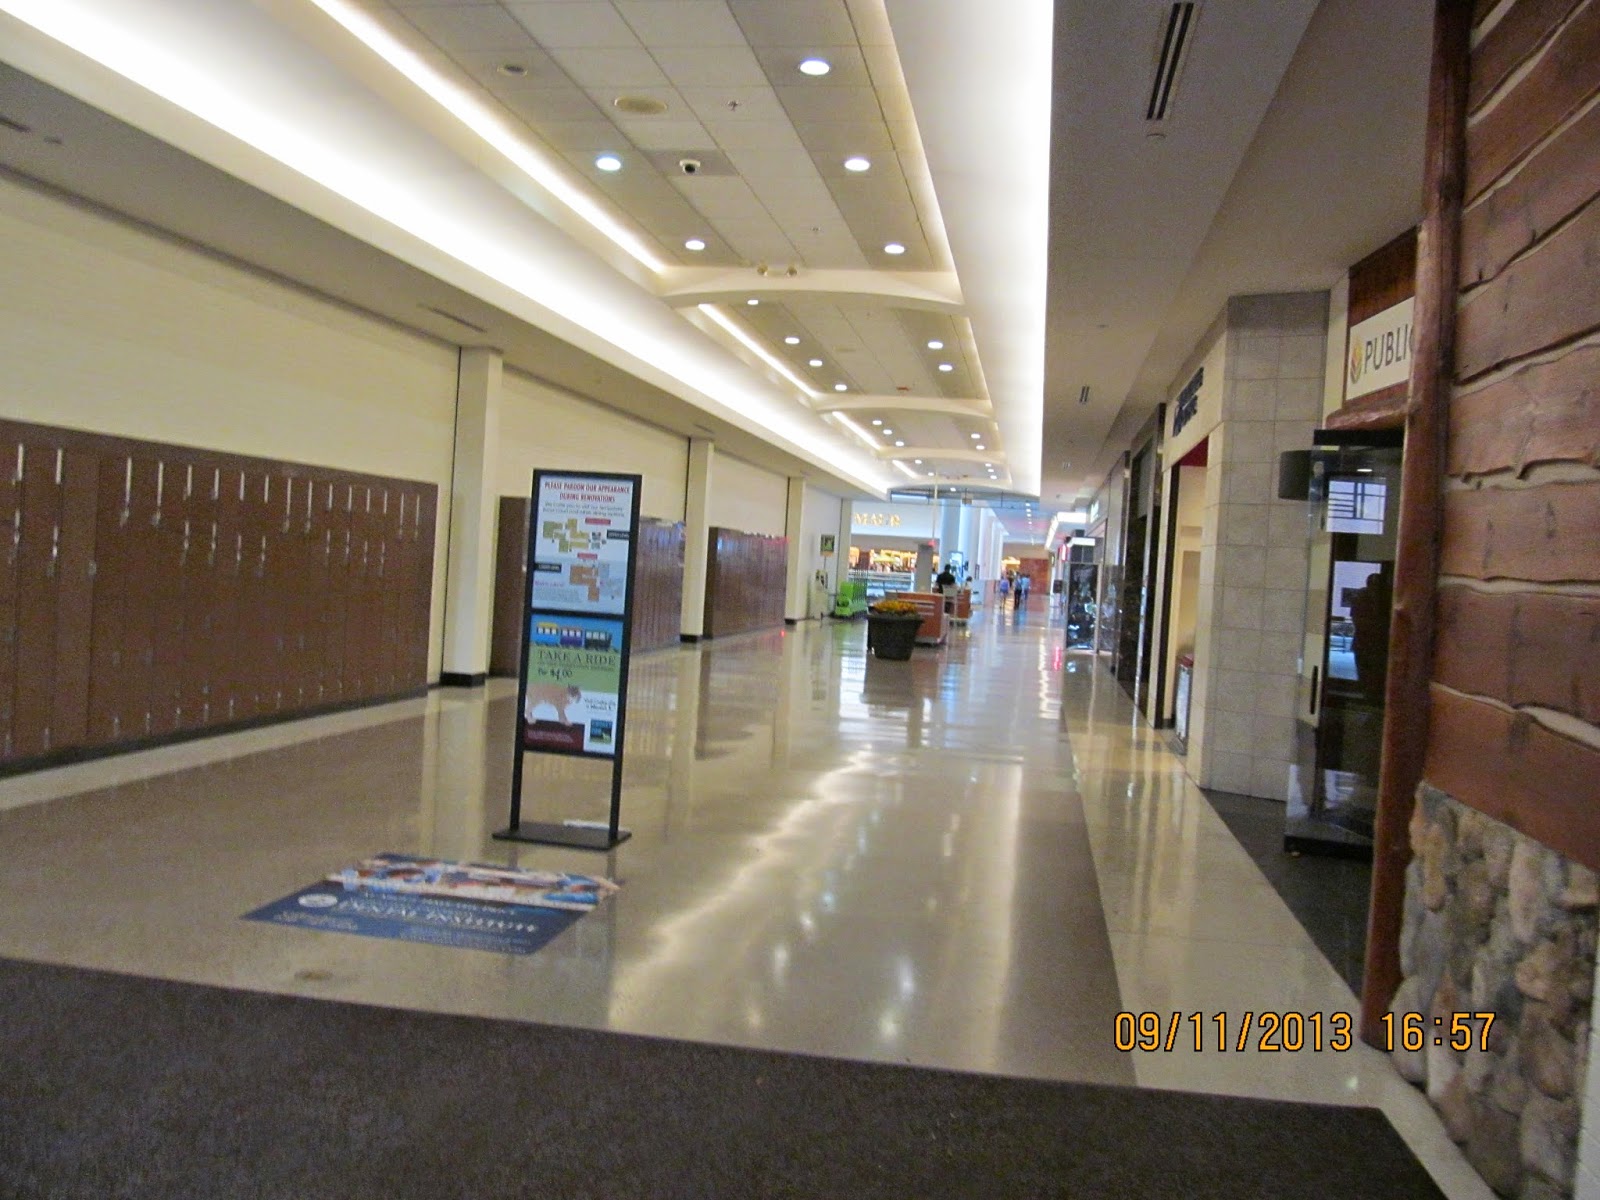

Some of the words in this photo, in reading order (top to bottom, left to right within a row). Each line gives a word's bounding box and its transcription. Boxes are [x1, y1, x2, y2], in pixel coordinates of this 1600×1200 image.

[544, 481, 562, 490] PLEASE
[564, 482, 585, 491] PARDON
[586, 484, 598, 492] OUR
[599, 484, 630, 494] APPEARANCE
[560, 493, 579, 501] DURING
[580, 494, 615, 503] RENOVATIONS
[538, 650, 569, 662] TAKE
[575, 653, 582, 663] A
[586, 654, 616, 666] RIDE
